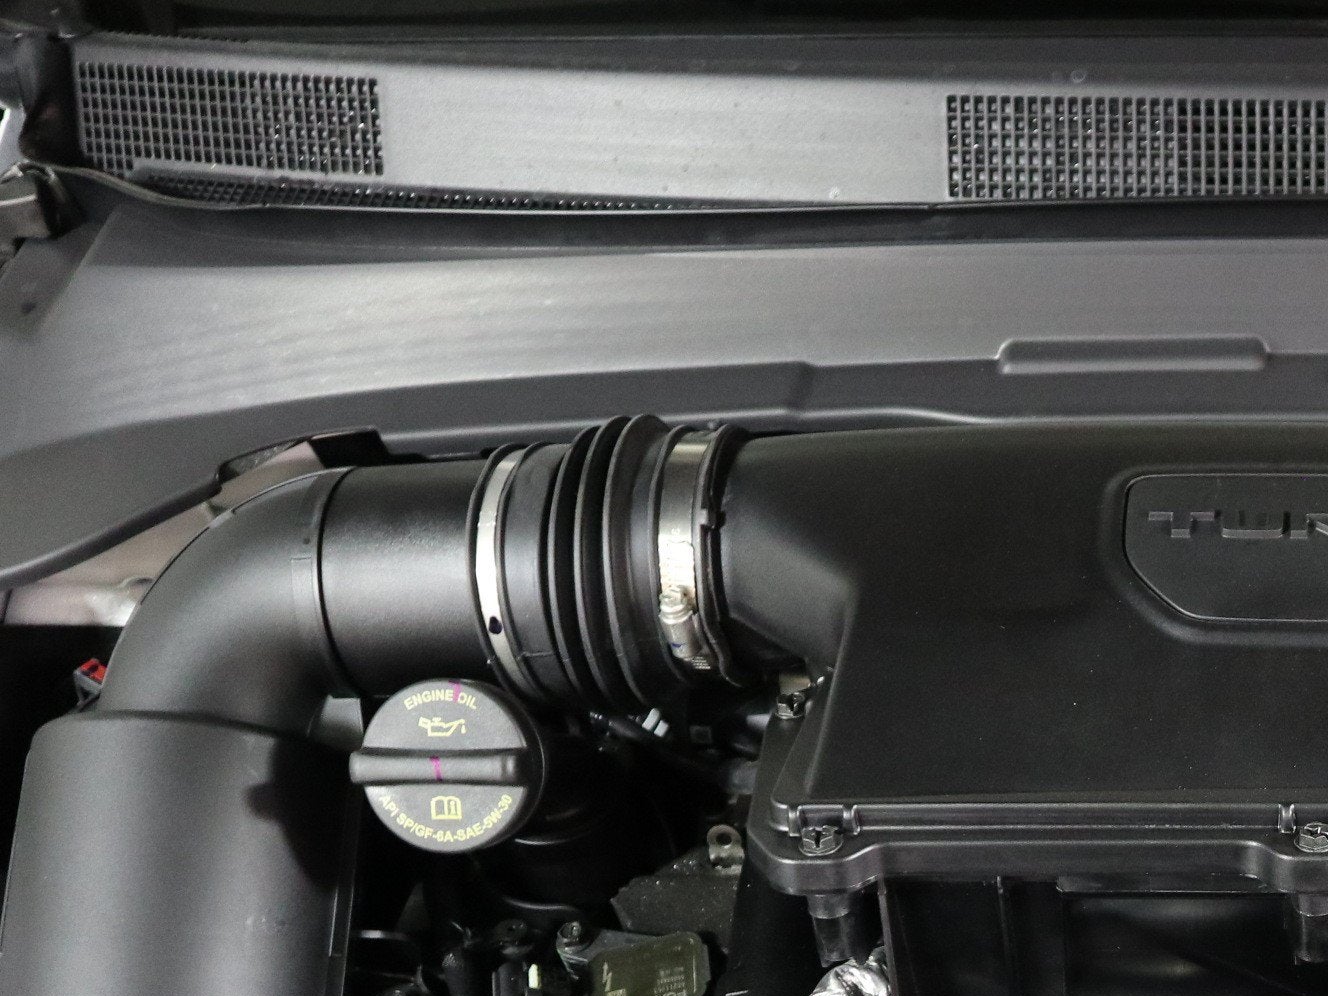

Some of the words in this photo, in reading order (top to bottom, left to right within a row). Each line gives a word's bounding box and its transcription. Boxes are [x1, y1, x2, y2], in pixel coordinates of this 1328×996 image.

[403, 689, 454, 710] ENGINE
[457, 691, 477, 710] OIL
[379, 794, 399, 817] API
